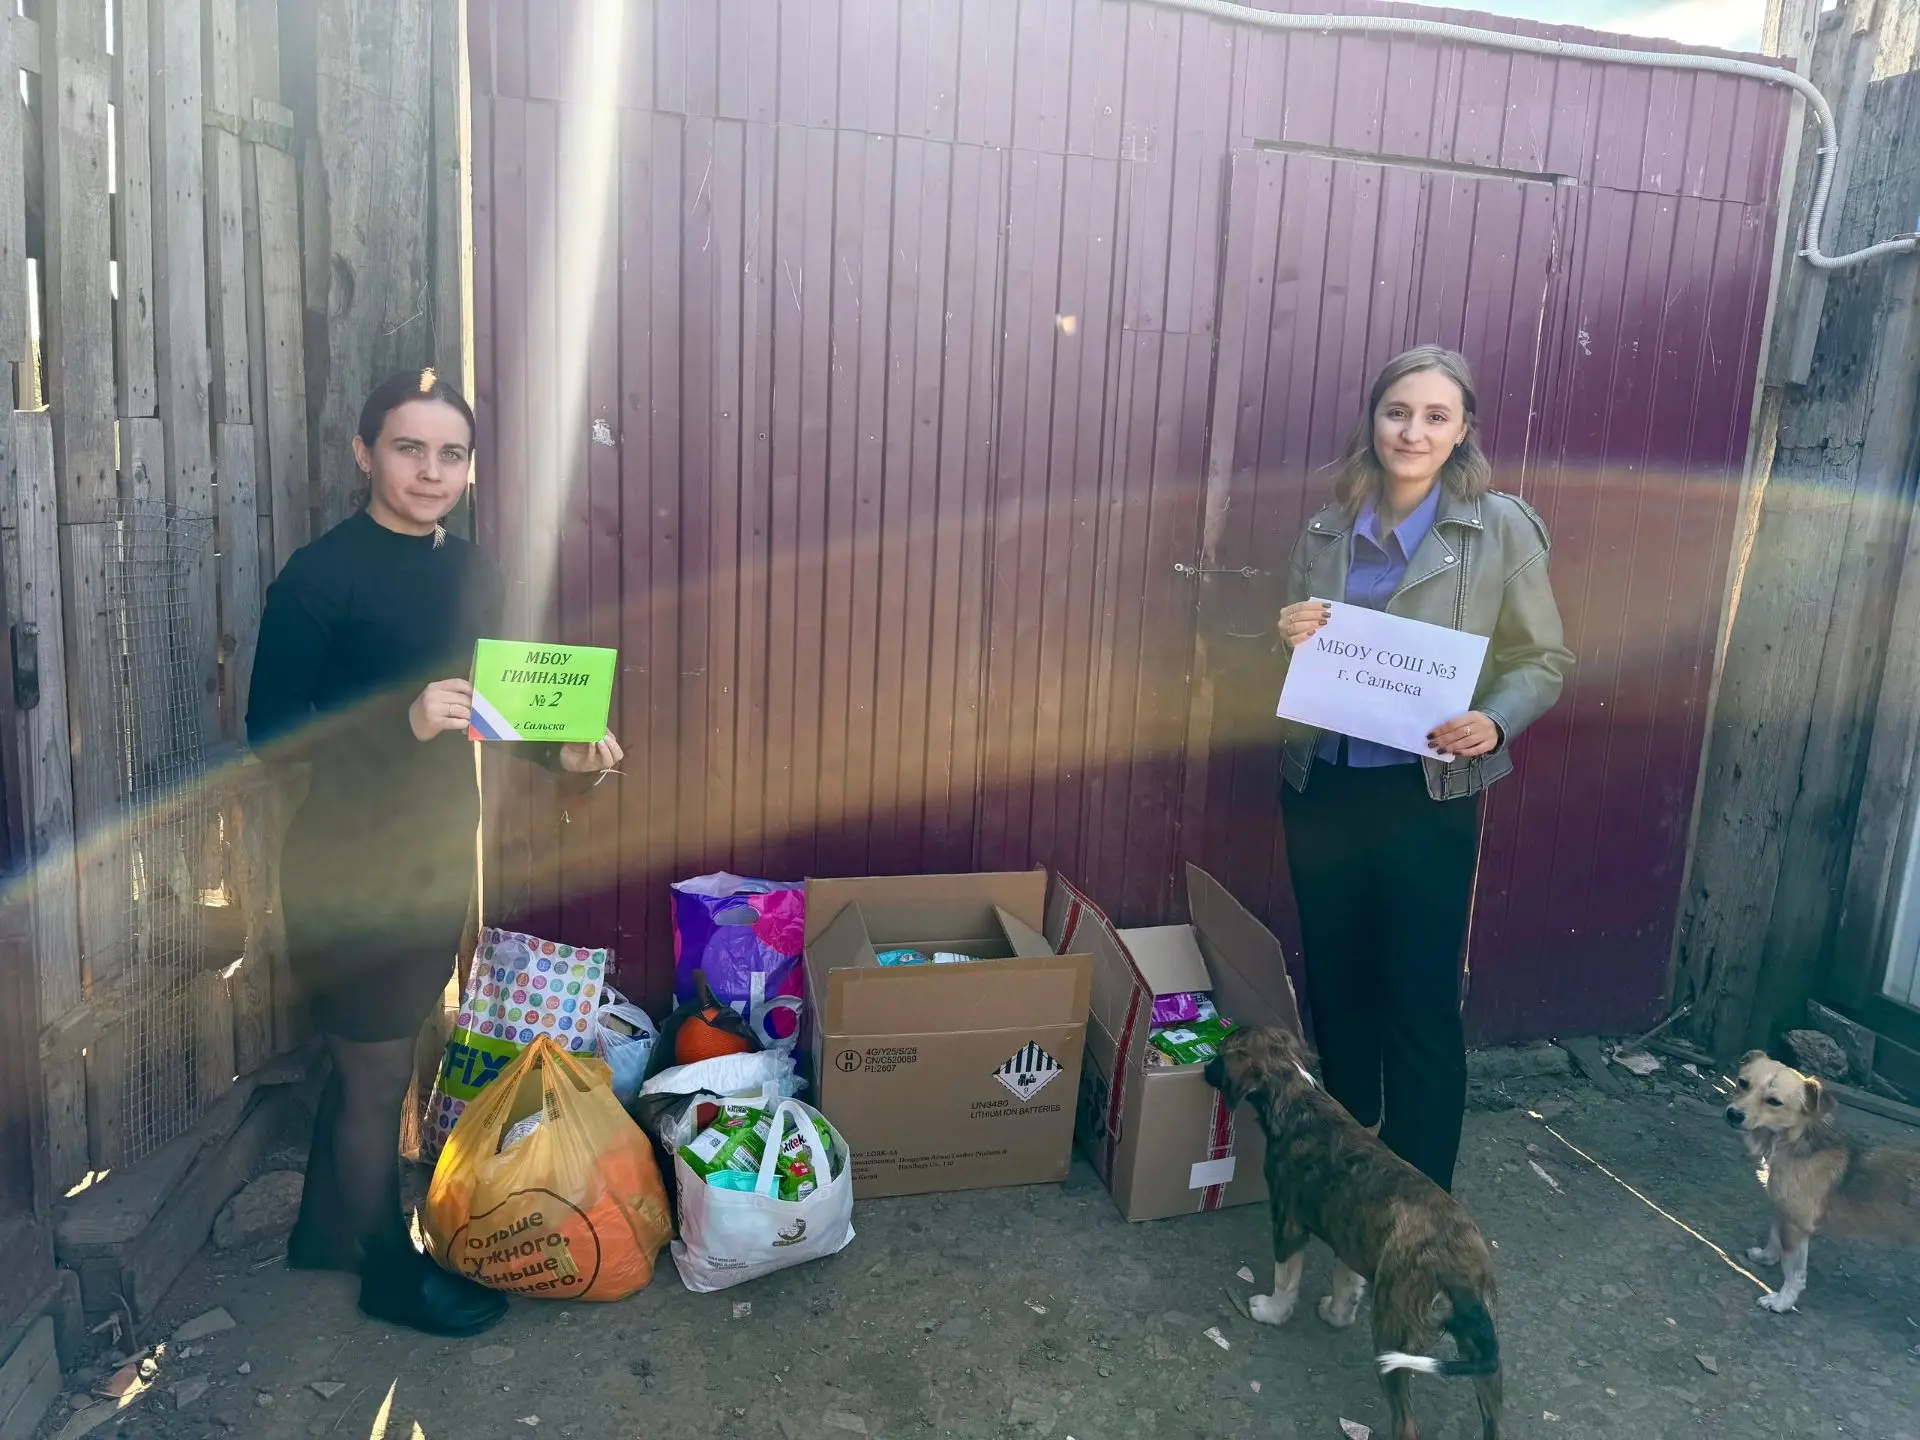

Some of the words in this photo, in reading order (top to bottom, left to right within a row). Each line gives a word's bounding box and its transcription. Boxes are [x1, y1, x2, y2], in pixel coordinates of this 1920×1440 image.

[525, 651, 572, 666] МБОУ
[1316, 637, 1372, 661] МБОУ
[1376, 650, 1424, 673] СОШ
[1426, 661, 1457, 680] №3
[501, 669, 590, 686] ГИМНАЗИЯ
[1337, 669, 1349, 681] г.
[1355, 669, 1422, 697] Сальска
[529, 694, 546, 707] №
[548, 691, 563, 707] 2
[523, 720, 566, 731] Сальска
[970, 1109, 1001, 1119] LITHIUM
[1003, 1107, 1017, 1117] ION
[1019, 1104, 1061, 1115] BATTERIES
[971, 1100, 1009, 1109] UN3480
[468, 1211, 543, 1249] ольше
